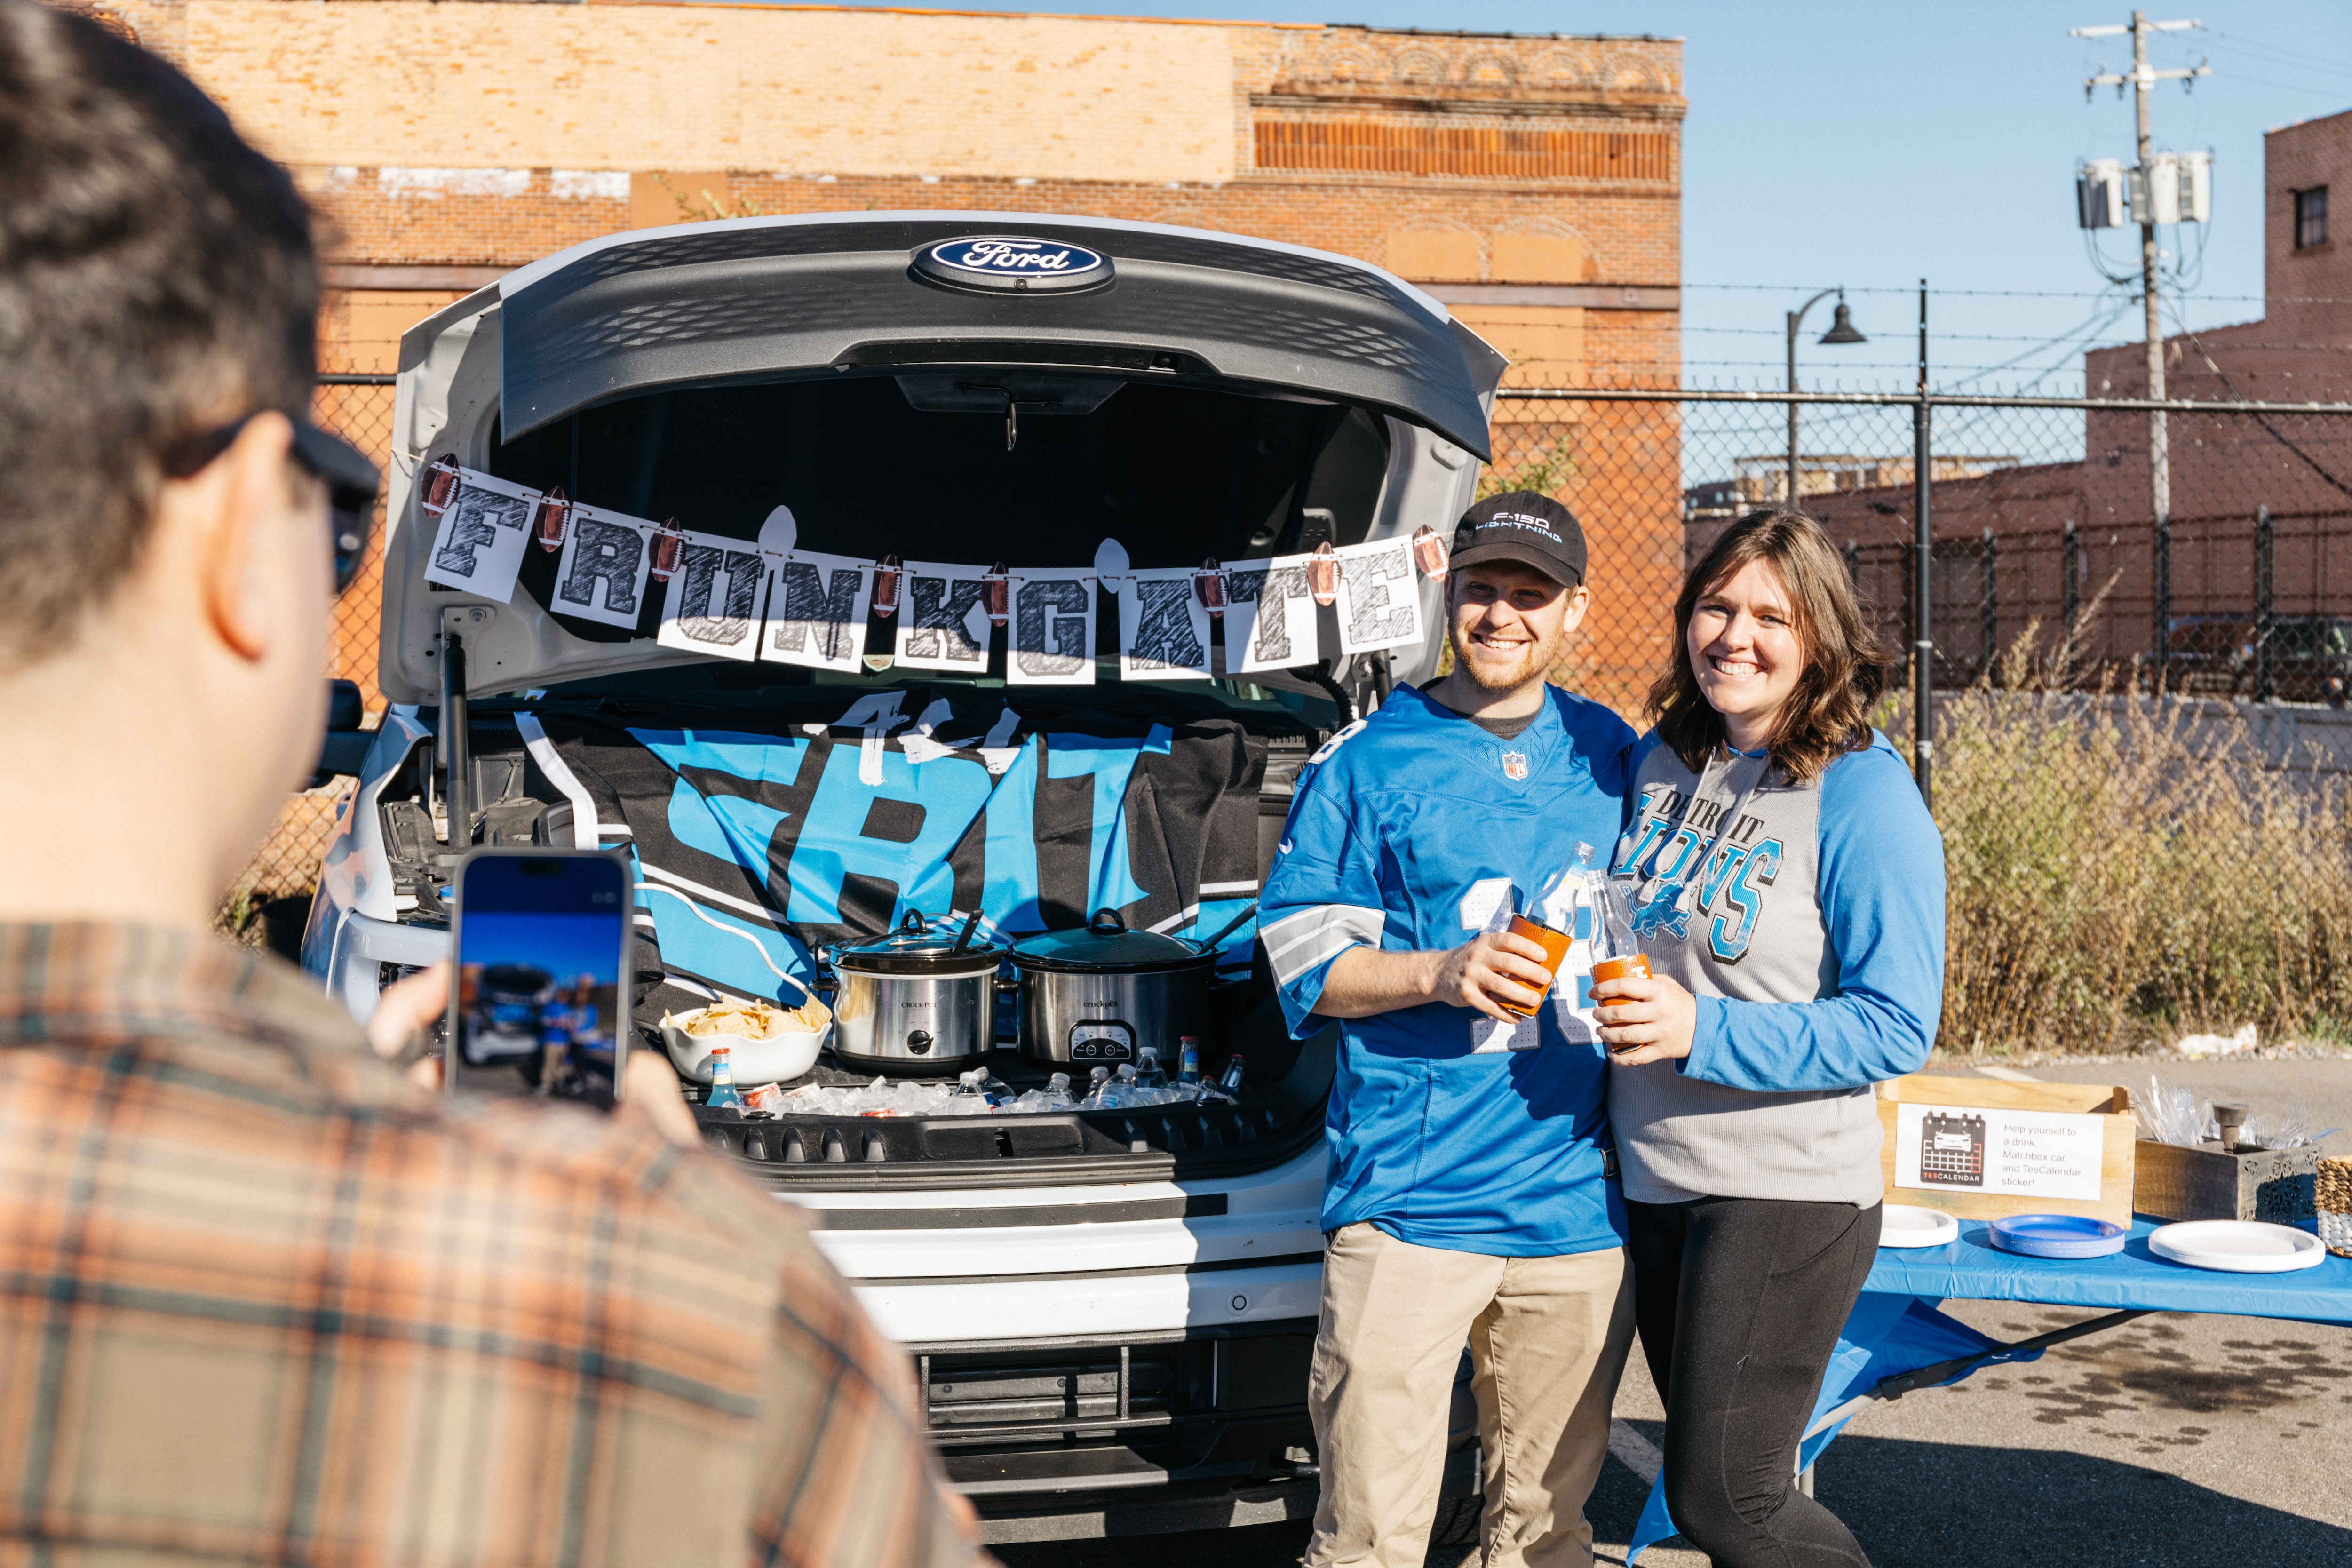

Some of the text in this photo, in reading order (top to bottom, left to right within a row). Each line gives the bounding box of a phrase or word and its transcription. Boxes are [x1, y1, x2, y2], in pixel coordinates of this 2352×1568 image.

[962, 240, 1070, 269] Ford
[1492, 512, 1549, 530] F-150
[1475, 520, 1563, 544] LIGHTNING
[1507, 764, 1525, 776] NFL
[2004, 1124, 2026, 1135] Help
[2028, 1127, 2066, 1136] yourself
[2012, 1138, 2037, 1148] drink,
[2003, 1151, 2067, 1163] Matchbox car,
[2023, 1164, 2082, 1177] TesCalendar
[1923, 1172, 1980, 1182] TESCALENDAR
[2002, 1177, 2034, 1187] sticker!
